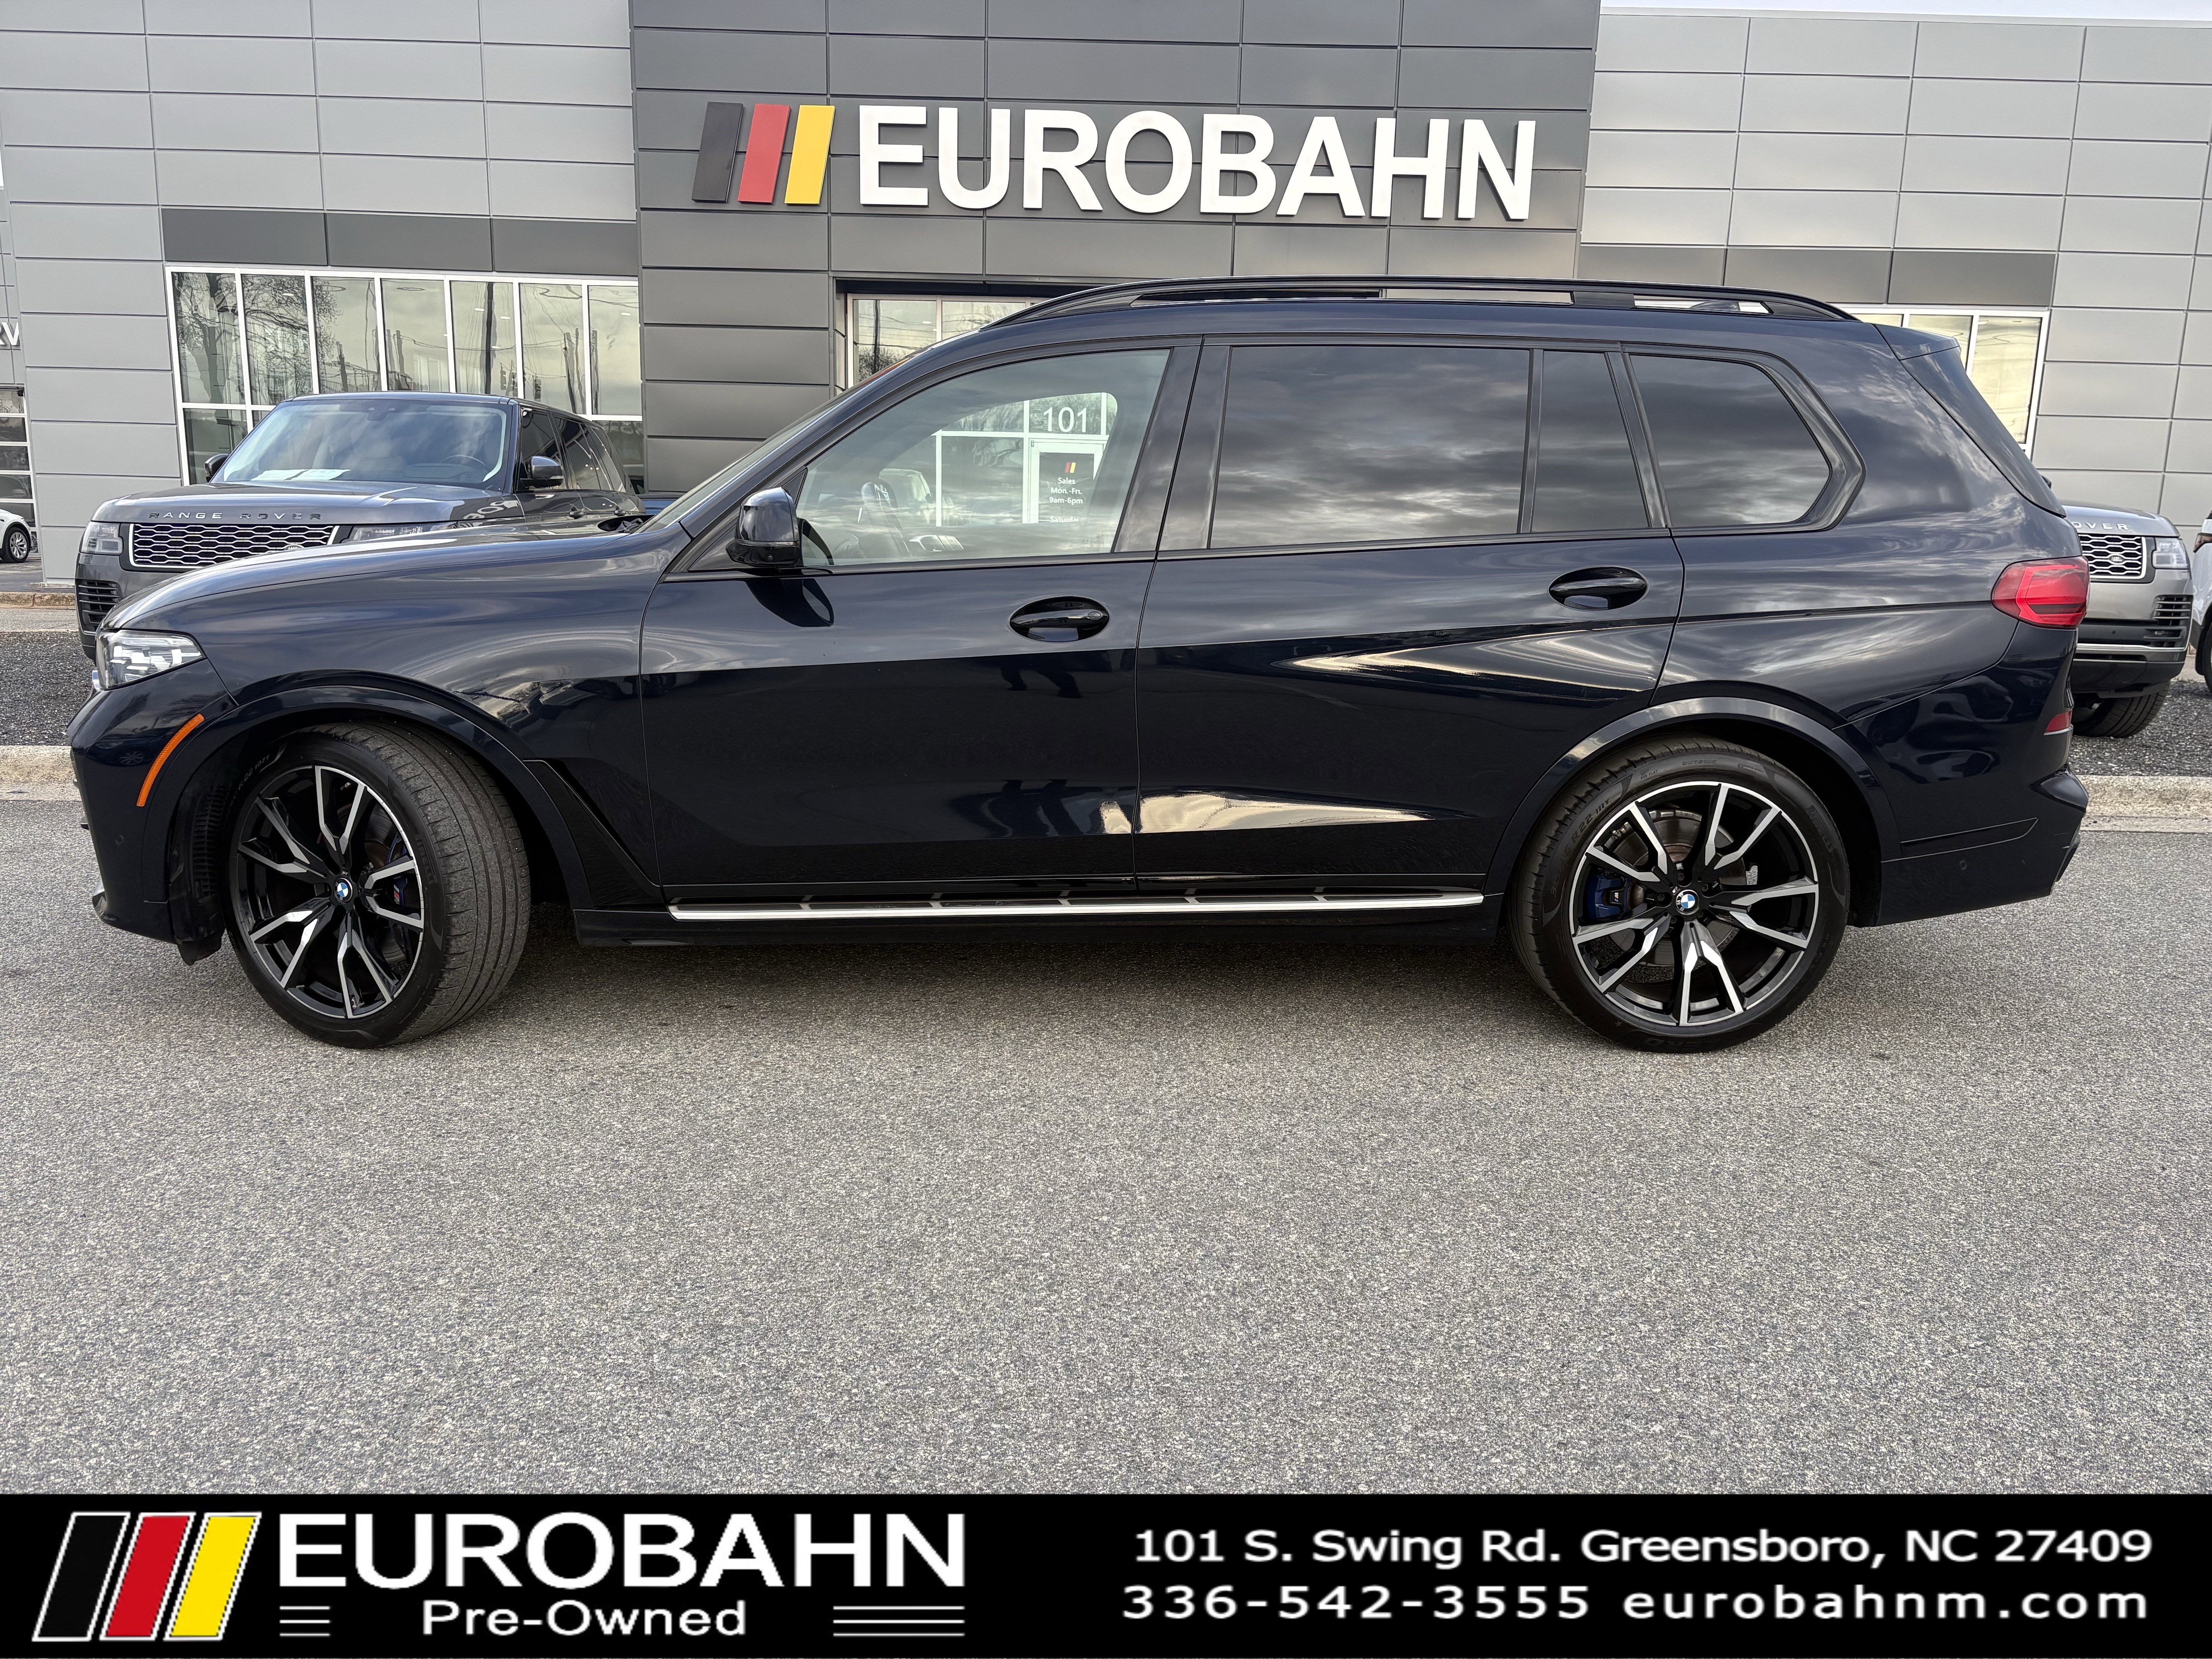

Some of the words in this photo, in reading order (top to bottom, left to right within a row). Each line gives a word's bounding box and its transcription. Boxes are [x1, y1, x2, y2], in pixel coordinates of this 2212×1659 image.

[859, 105, 1536, 219] EUROBAHN
[1043, 407, 1087, 433] 101
[1049, 496, 1083, 505] 9am-6pm
[1571, 813, 1593, 845] R22
